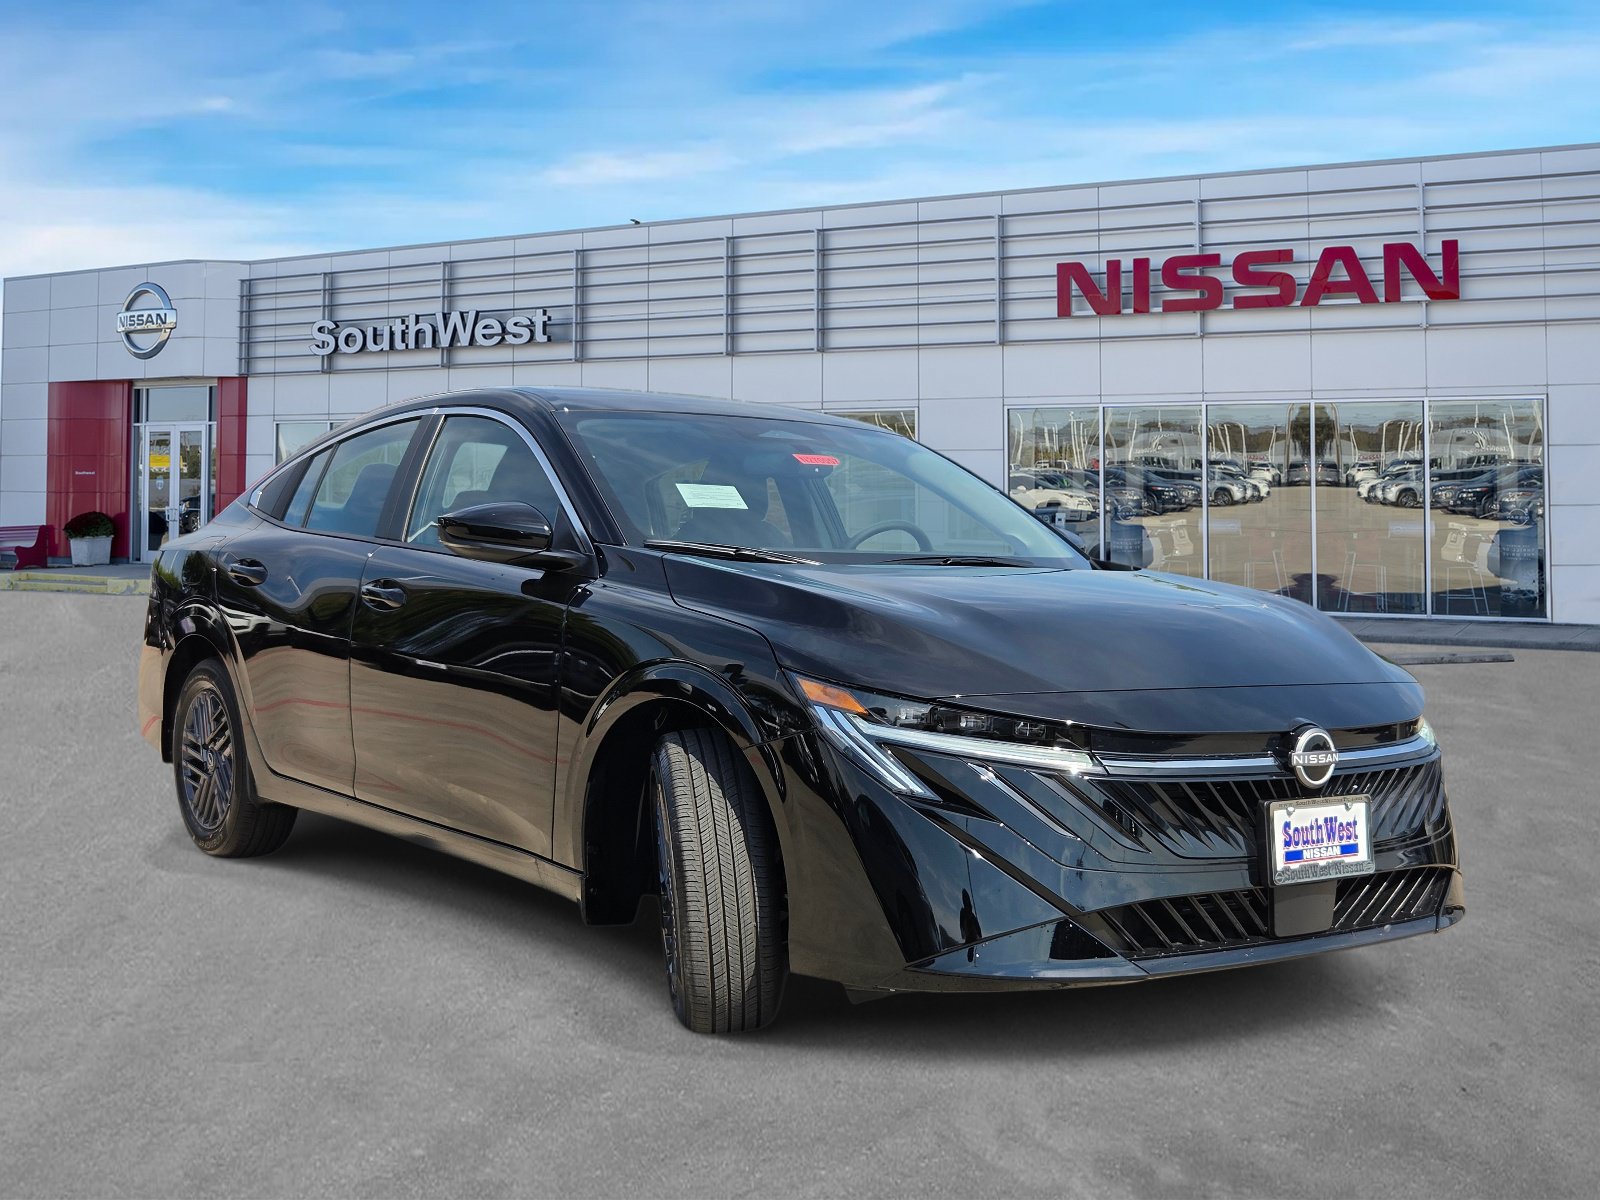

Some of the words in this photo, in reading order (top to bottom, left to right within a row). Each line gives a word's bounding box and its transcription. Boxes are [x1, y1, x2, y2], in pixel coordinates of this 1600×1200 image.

[1056, 239, 1461, 318] NISSAN
[119, 312, 167, 328] NISSAN
[309, 308, 550, 356] SouthWest
[1293, 753, 1339, 764] NISSAN
[1283, 815, 1359, 848] SouthWest
[1303, 846, 1342, 859] NISSAN
[1284, 864, 1332, 881] SouthWest
[1335, 861, 1364, 874] Nissan
